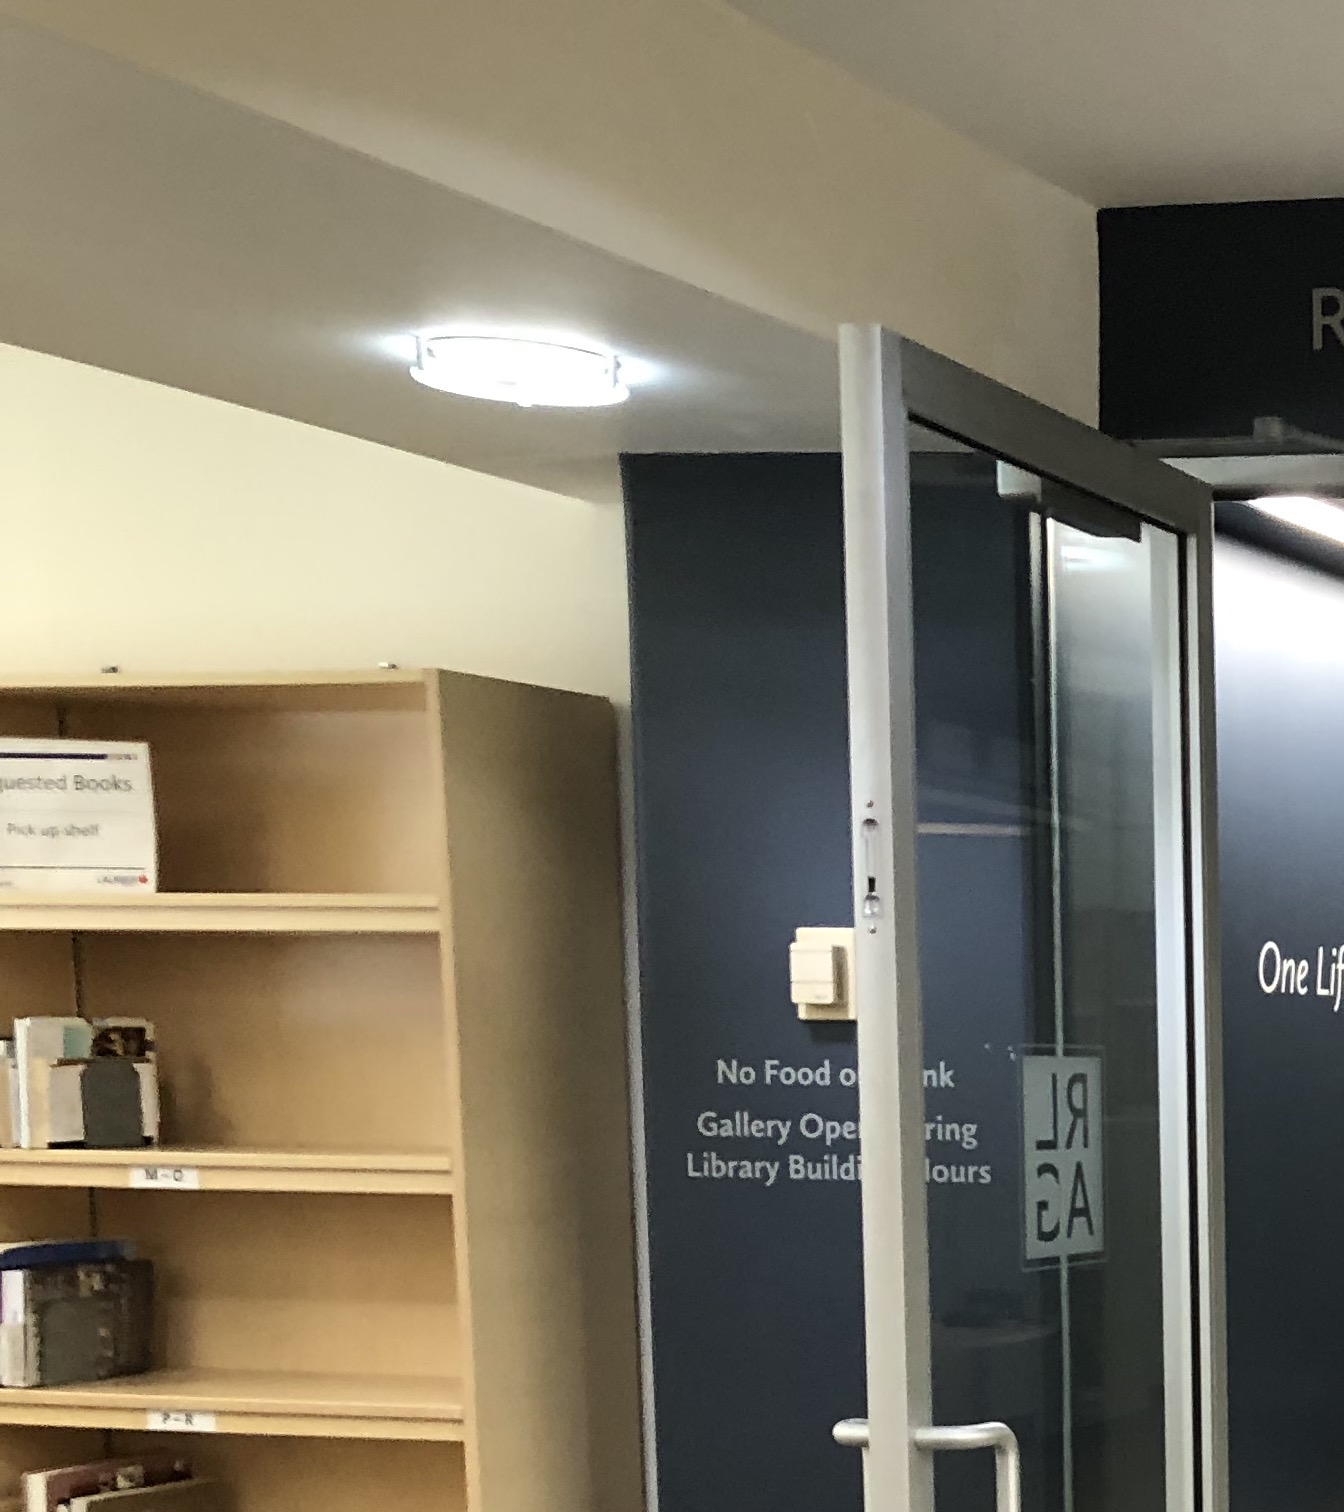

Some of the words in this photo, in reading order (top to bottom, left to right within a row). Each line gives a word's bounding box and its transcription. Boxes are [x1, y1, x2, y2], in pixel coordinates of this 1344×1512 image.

[73, 774, 133, 792] Books
[1258, 940, 1309, 996] One
[716, 1059, 756, 1085] No
[764, 1059, 831, 1087] Food
[839, 1068, 857, 1087] o
[697, 1111, 792, 1146] Gallery
[799, 1112, 861, 1146] Ope
[686, 1152, 780, 1187] Library
